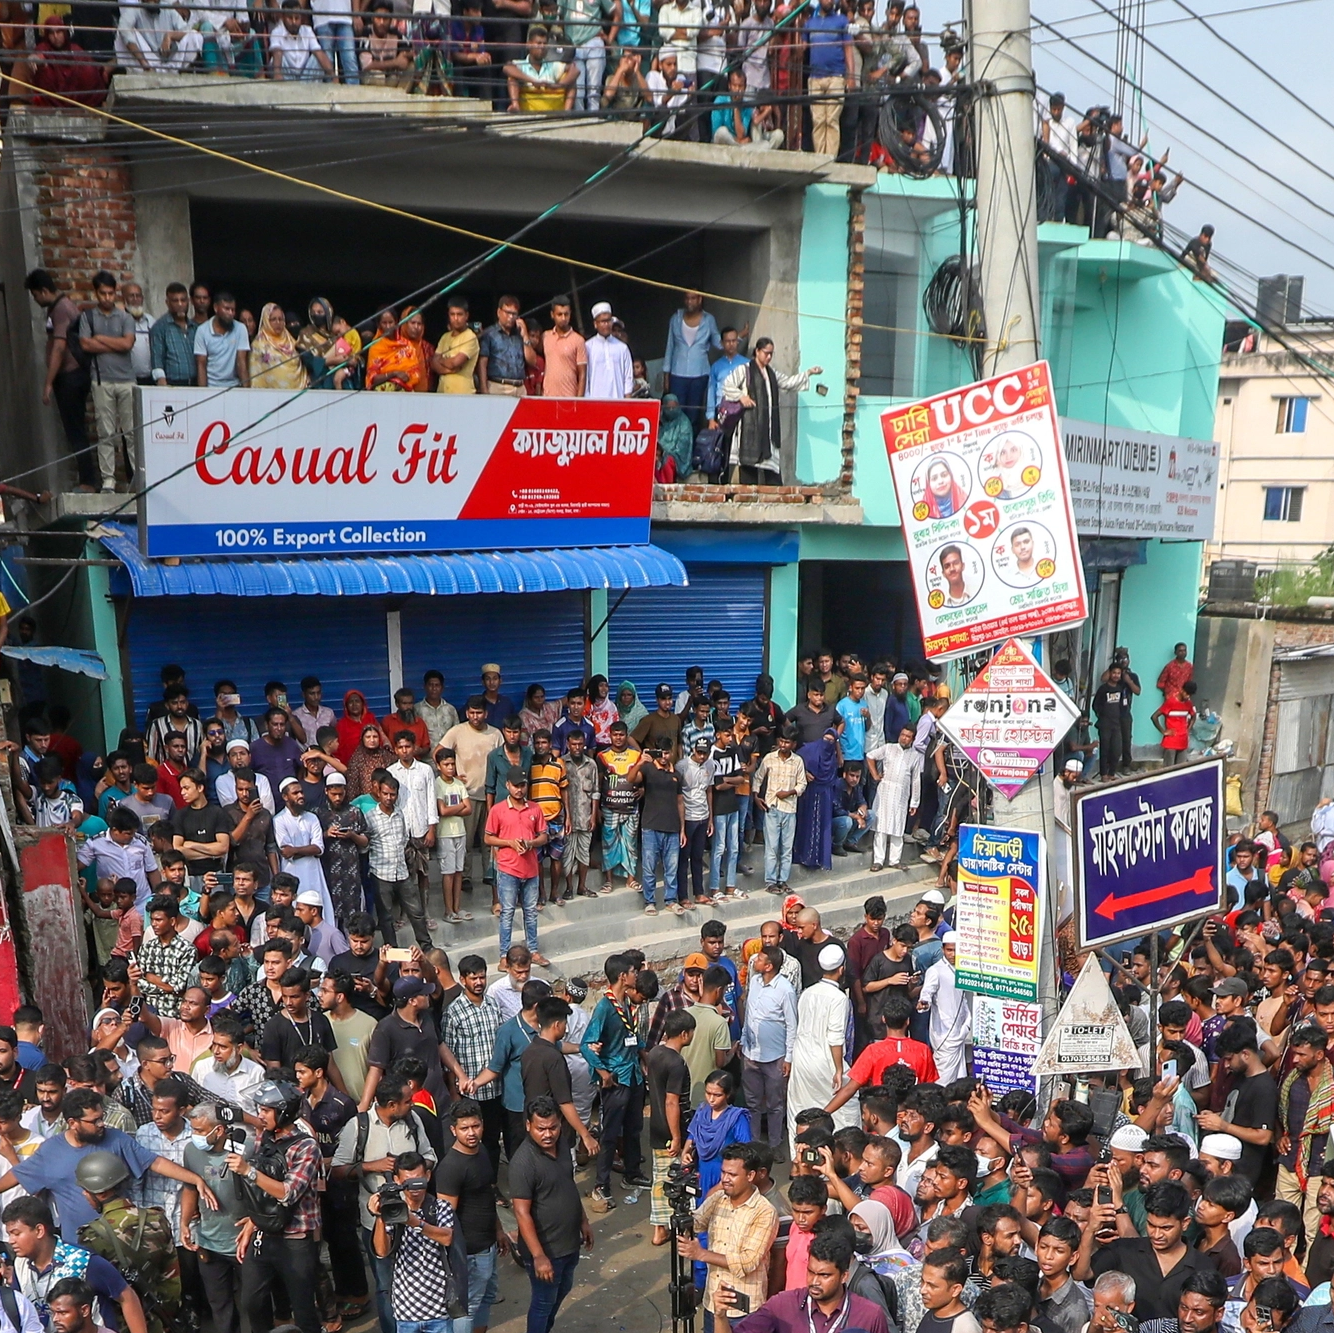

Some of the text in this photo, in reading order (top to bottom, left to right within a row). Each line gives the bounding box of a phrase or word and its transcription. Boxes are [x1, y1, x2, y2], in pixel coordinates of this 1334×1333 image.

[930, 375, 1025, 434] UCC
[889, 405, 930, 433] ঢাবি
[155, 431, 185, 440] Casual Fit
[512, 415, 651, 467] ক্যাজুয়াল ফিট
[894, 426, 931, 450] সেরা
[974, 428, 991, 440] Time
[196, 420, 459, 486] Casual Fit
[966, 507, 996, 535] ১ম
[215, 525, 427, 551] 100% Export Collection
[958, 723, 1056, 745] মহিলা হোস্টেল
[972, 833, 1023, 862] দিয়াবাড়ী
[1089, 795, 1214, 878] মাইলস্টোন কলেজ
[1007, 860, 1033, 876] সেন্টার
[1015, 887, 1030, 899] সকল
[1011, 940, 1033, 959] ছাড়!
[1002, 1004, 1039, 1024] জমির
[1073, 1026, 1105, 1034] TO-LET
[1002, 1037, 1035, 1053] বিক্রি হবে
